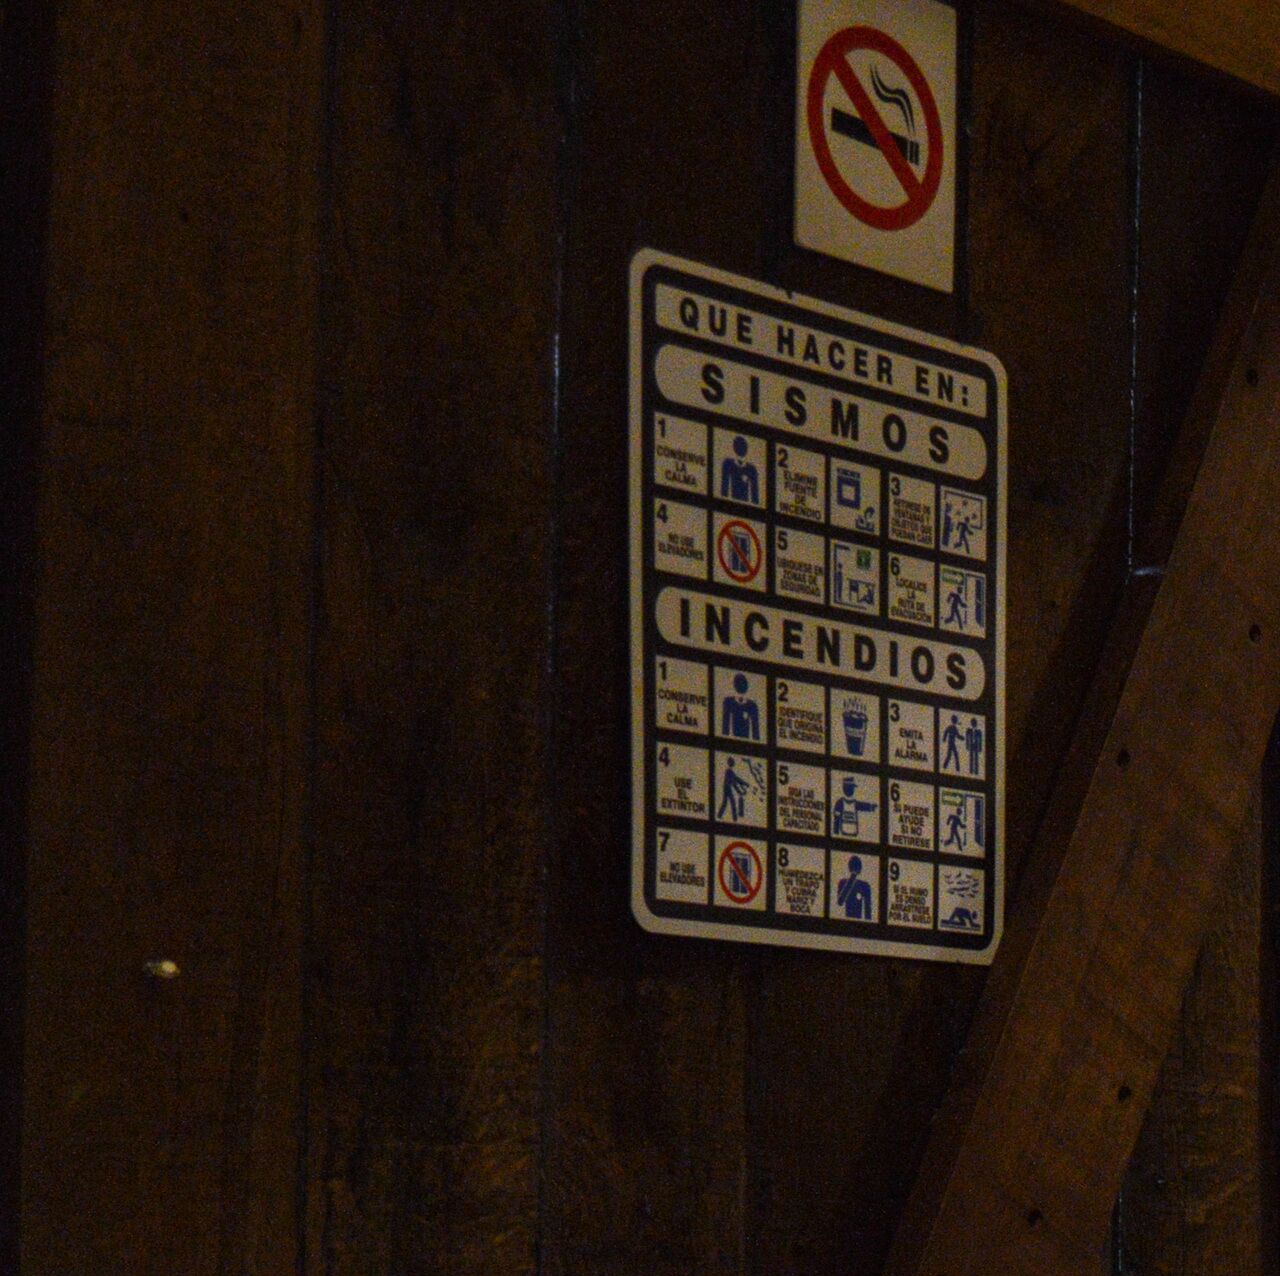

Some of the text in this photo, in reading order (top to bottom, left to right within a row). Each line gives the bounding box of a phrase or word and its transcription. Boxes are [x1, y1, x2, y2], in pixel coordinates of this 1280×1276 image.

[679, 297, 969, 406] QUE HACER EN:
[701, 363, 949, 464] SISMOS
[657, 416, 665, 438] 1
[657, 444, 705, 467] CONSERVE
[778, 446, 788, 469] 2
[675, 460, 686, 474] LA
[665, 469, 696, 487] CALMA
[891, 475, 900, 497] 3
[656, 502, 668, 524] 4
[779, 501, 821, 520] INCENDIO
[778, 529, 788, 551] 5
[890, 555, 899, 576] 6
[907, 589, 915, 600] LA
[680, 597, 966, 690] INCENDIOS
[659, 660, 666, 681] 1
[658, 687, 707, 707] CONSERVE
[778, 681, 788, 702] 2
[676, 703, 688, 714] LA
[889, 702, 900, 723] 3
[666, 711, 698, 727] CALMA
[779, 727, 786, 738] EL
[898, 727, 923, 741] EMITA
[906, 739, 916, 750] LA
[658, 746, 670, 767] 4
[894, 747, 928, 763] ALARMA
[674, 776, 692, 789] USE
[778, 764, 789, 786] 5
[677, 788, 688, 800] EL
[890, 782, 900, 802] 6
[661, 797, 704, 813] EXTINTOR
[903, 803, 929, 818] PUEDE
[898, 813, 924, 826] AYUDE
[901, 824, 922, 836] SI NO
[658, 831, 670, 852] 7
[892, 833, 930, 848] RETIRESE
[778, 846, 789, 868] 8
[669, 861, 696, 875] NO USE
[890, 861, 900, 882] 9
[659, 870, 704, 887] ELEVADORES
[790, 903, 811, 914] BOCA
